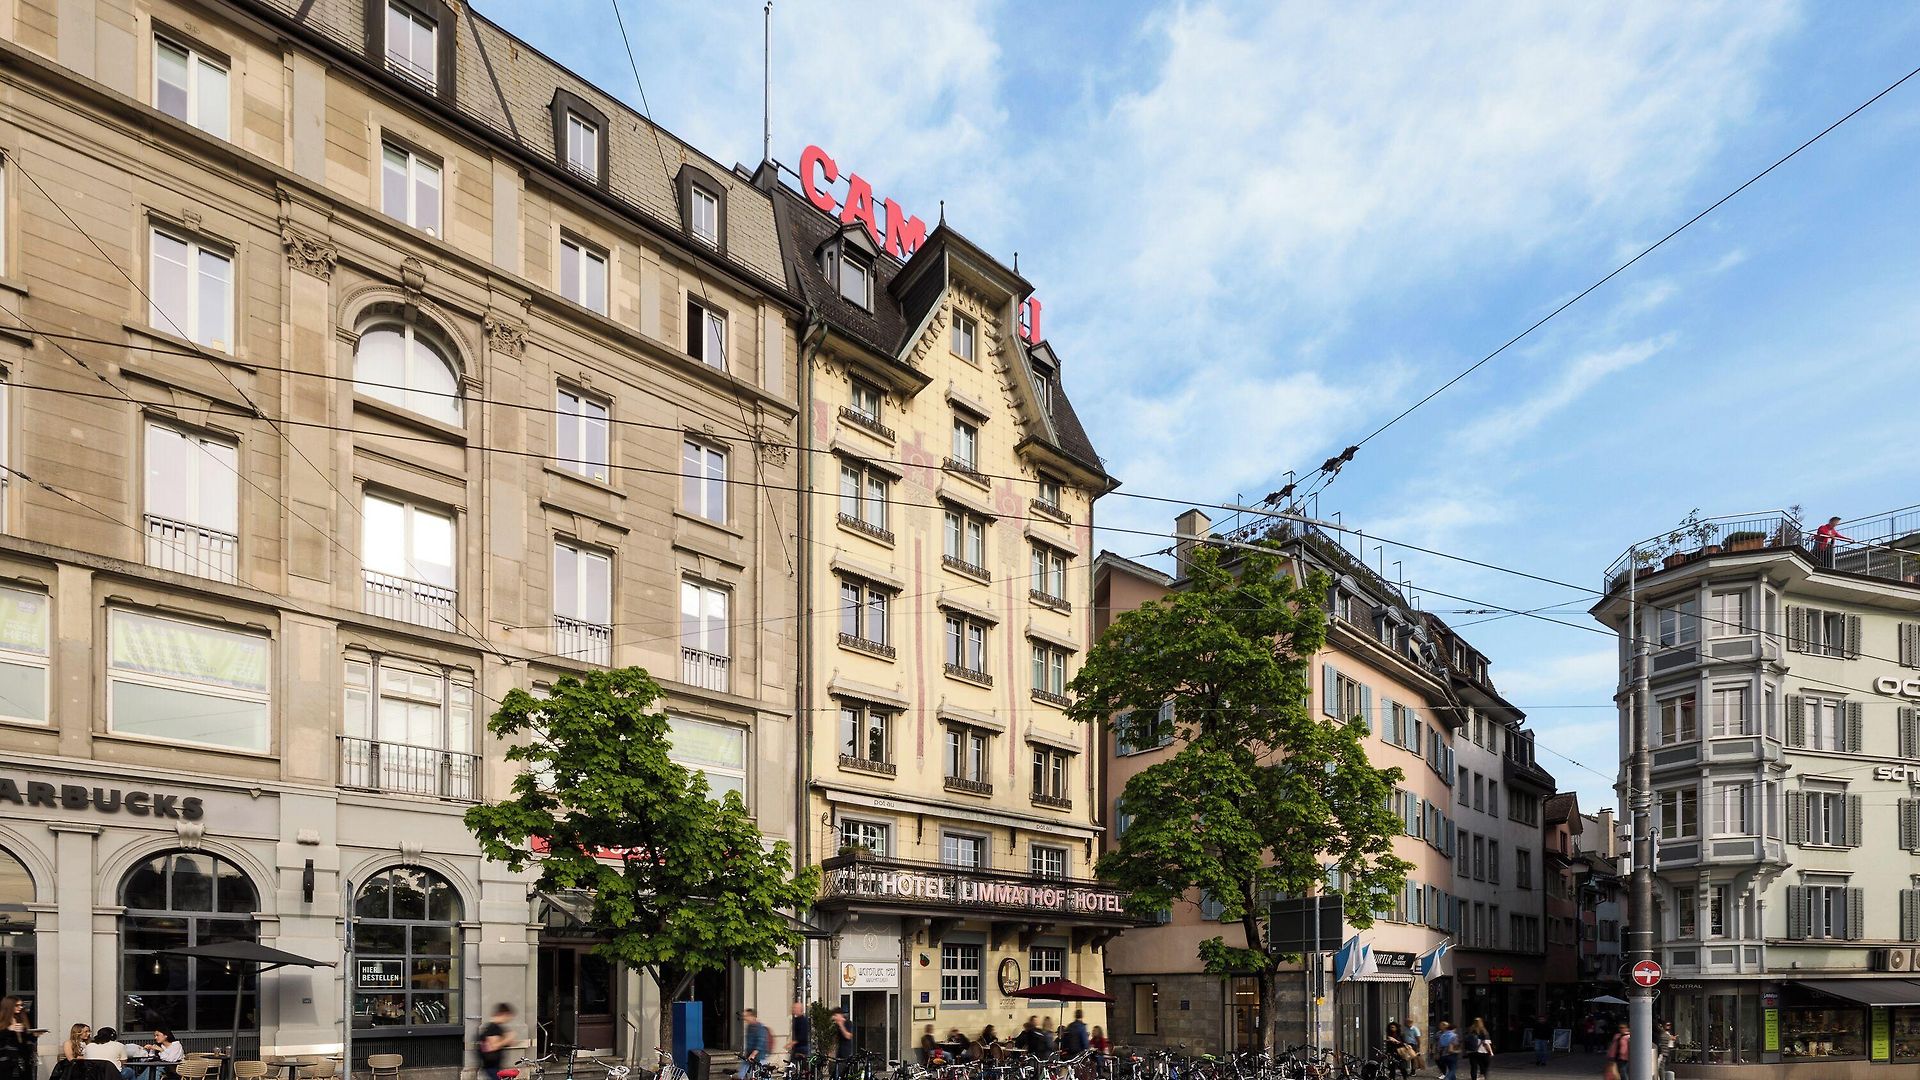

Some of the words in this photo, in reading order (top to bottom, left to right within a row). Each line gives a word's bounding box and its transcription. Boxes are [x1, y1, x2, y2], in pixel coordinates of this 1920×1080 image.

[882, 872, 950, 899] HOTEL
[962, 881, 1066, 908] LIMMATHOF
[1075, 891, 1124, 912] HOTEL
[362, 966, 378, 974] HIER
